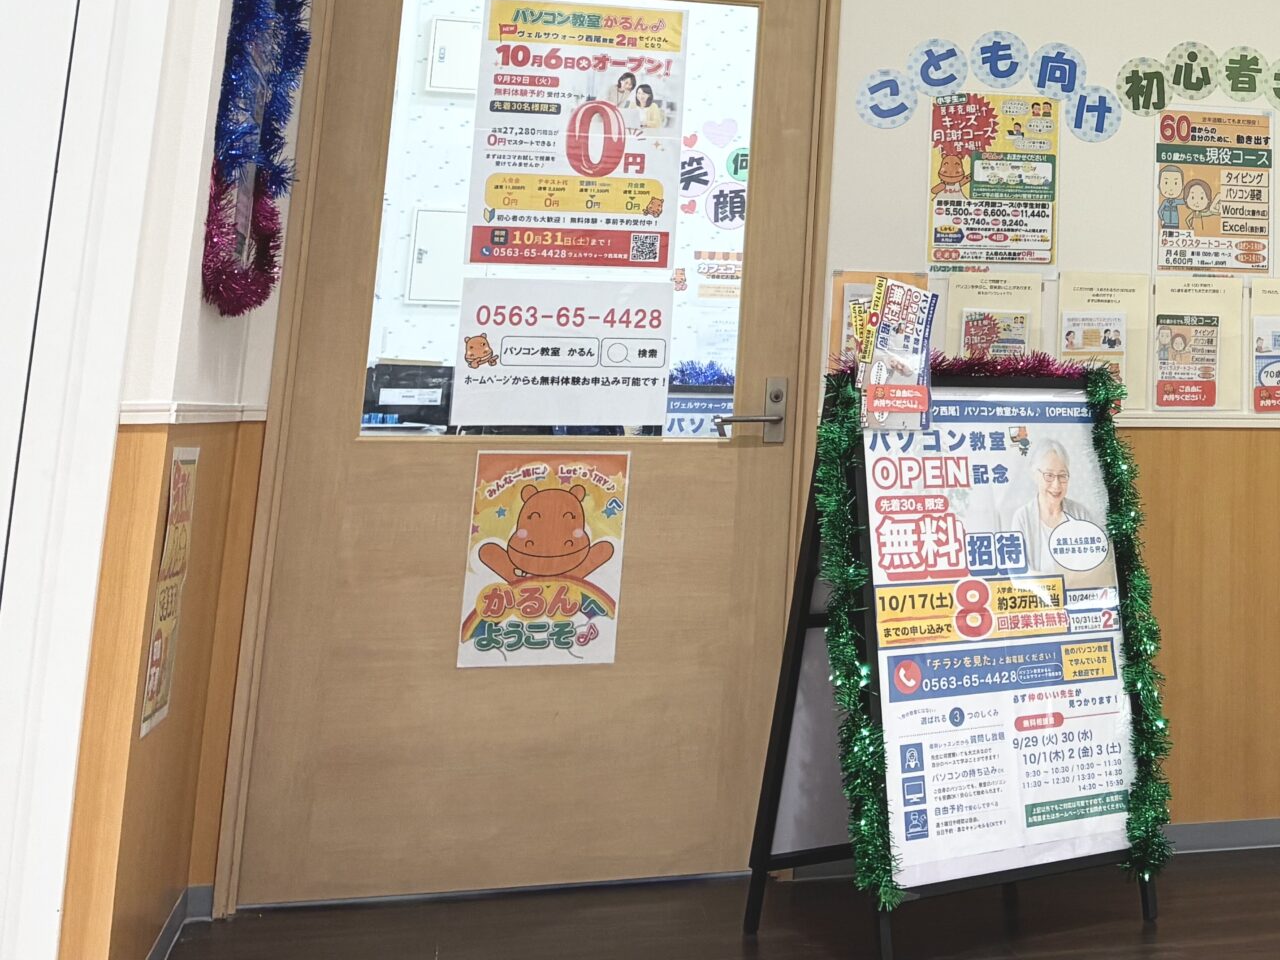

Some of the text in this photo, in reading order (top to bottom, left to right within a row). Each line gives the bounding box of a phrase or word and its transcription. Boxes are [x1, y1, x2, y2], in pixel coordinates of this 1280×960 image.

[868, 41, 1112, 134] こども向け
[941, 115, 978, 129] キッズ
[1160, 114, 1191, 142] 60
[933, 127, 995, 142] 月謝コース
[1225, 171, 1264, 185] タイピング
[1225, 187, 1263, 201] パソコン基礎
[502, 196, 641, 211] 0円 0円 0円 0円
[1161, 238, 1234, 249] ゆっくりスタートコース
[493, 247, 566, 259] 0563-65-4428
[476, 305, 663, 329] 0563-65-4428
[503, 346, 596, 358] パソコン教室 かるん
[637, 349, 659, 360] 検索
[869, 430, 1007, 452] パソコン教室
[872, 456, 1009, 490] OPEN 記念
[875, 512, 1023, 570] 無料 招待
[878, 592, 954, 612] 10/17(土)
[954, 577, 994, 639] 8
[474, 620, 577, 652] ようこそ
[883, 623, 953, 638] までの申し込みで
[922, 669, 1018, 692] 0563-65-4428
